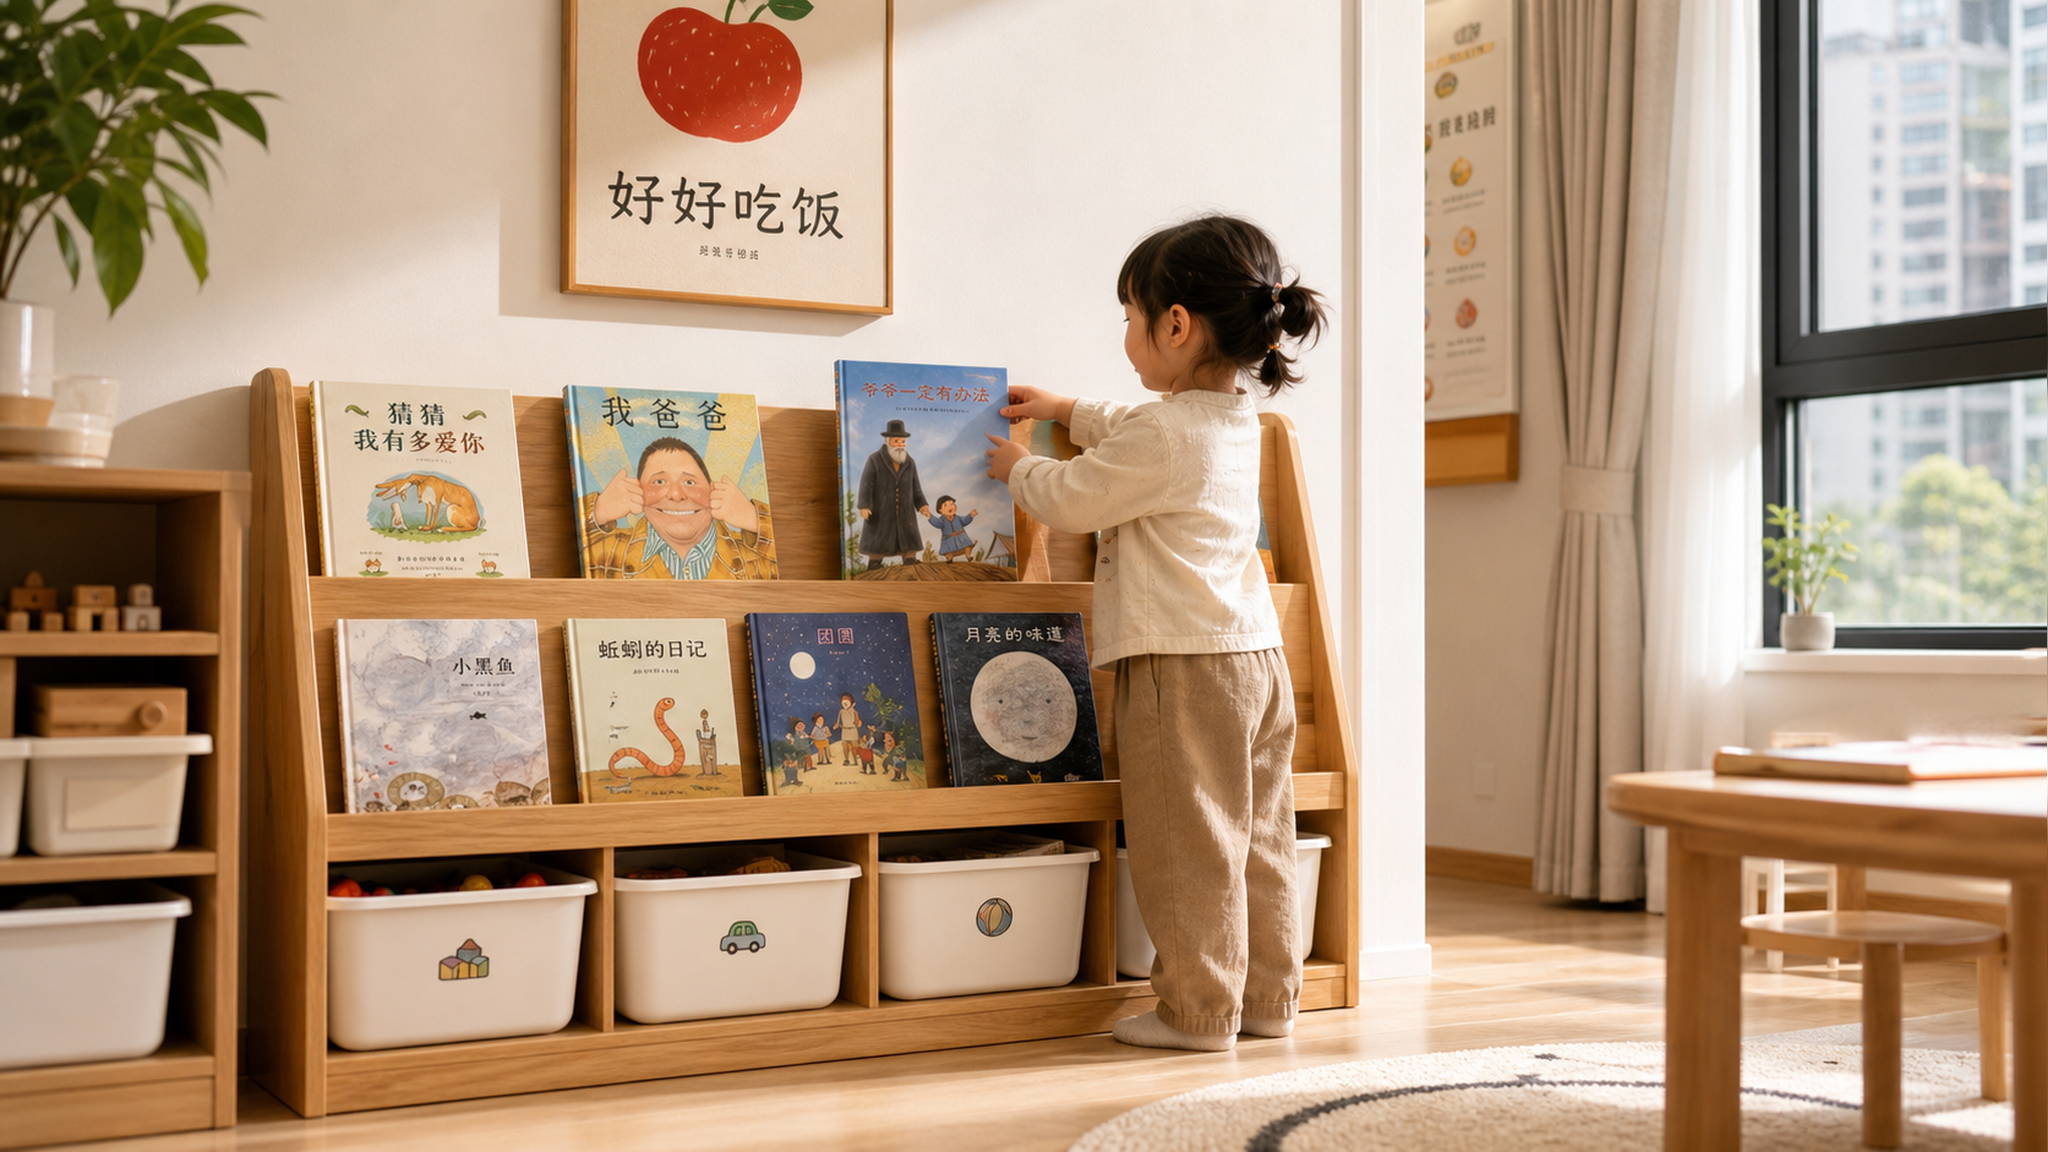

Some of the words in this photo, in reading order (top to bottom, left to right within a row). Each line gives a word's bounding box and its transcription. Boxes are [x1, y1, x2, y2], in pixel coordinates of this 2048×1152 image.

[608, 170, 844, 240] 好好吃饭
[862, 382, 990, 403] 爷爷一定有办法
[388, 402, 444, 426] 猜猜
[601, 396, 727, 431] 我爸爸
[354, 428, 485, 454] 我有多爱你
[965, 626, 1064, 643] 月亮的味道
[598, 640, 707, 659] 蚯蚓的日记
[452, 657, 515, 675] 小黑鱼
